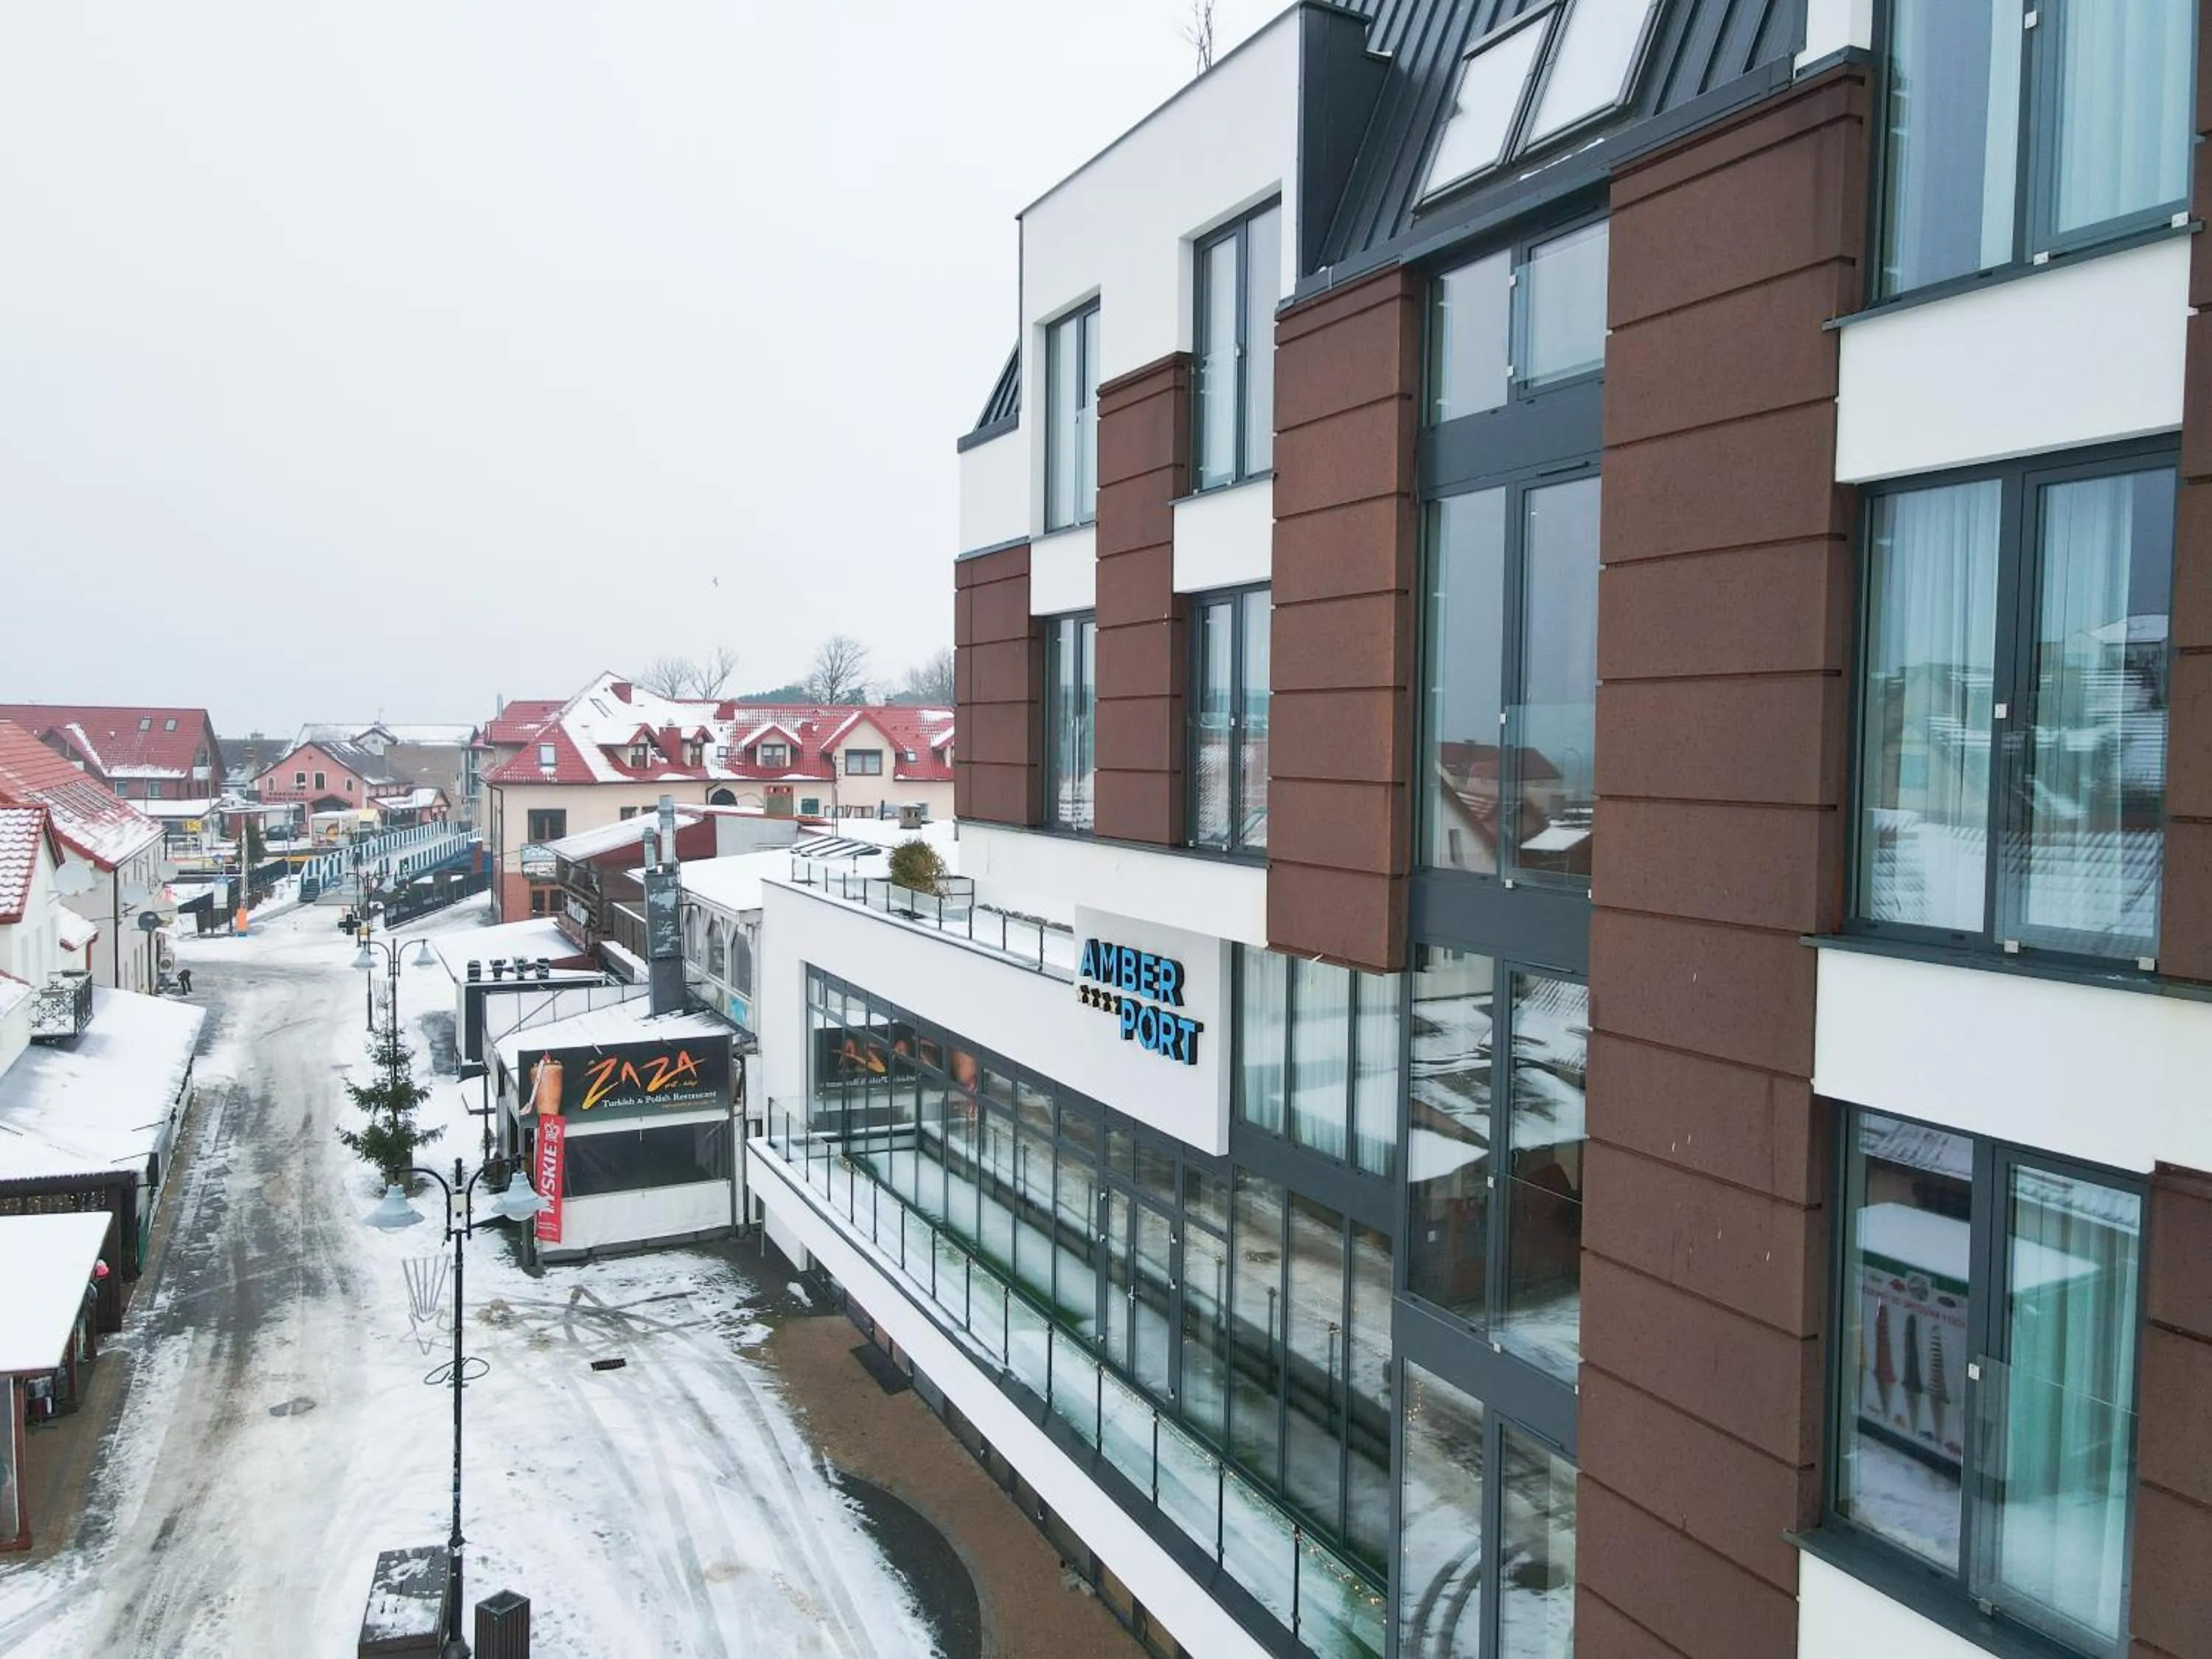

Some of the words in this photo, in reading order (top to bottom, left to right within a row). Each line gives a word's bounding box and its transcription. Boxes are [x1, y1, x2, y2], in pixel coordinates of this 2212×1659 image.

[1079, 939, 1185, 1006] AMBER
[1120, 998, 1204, 1065] PORT
[580, 1050, 706, 1110] ZAZA
[602, 1096, 635, 1107] Turkish
[645, 1094, 672, 1105] Polish
